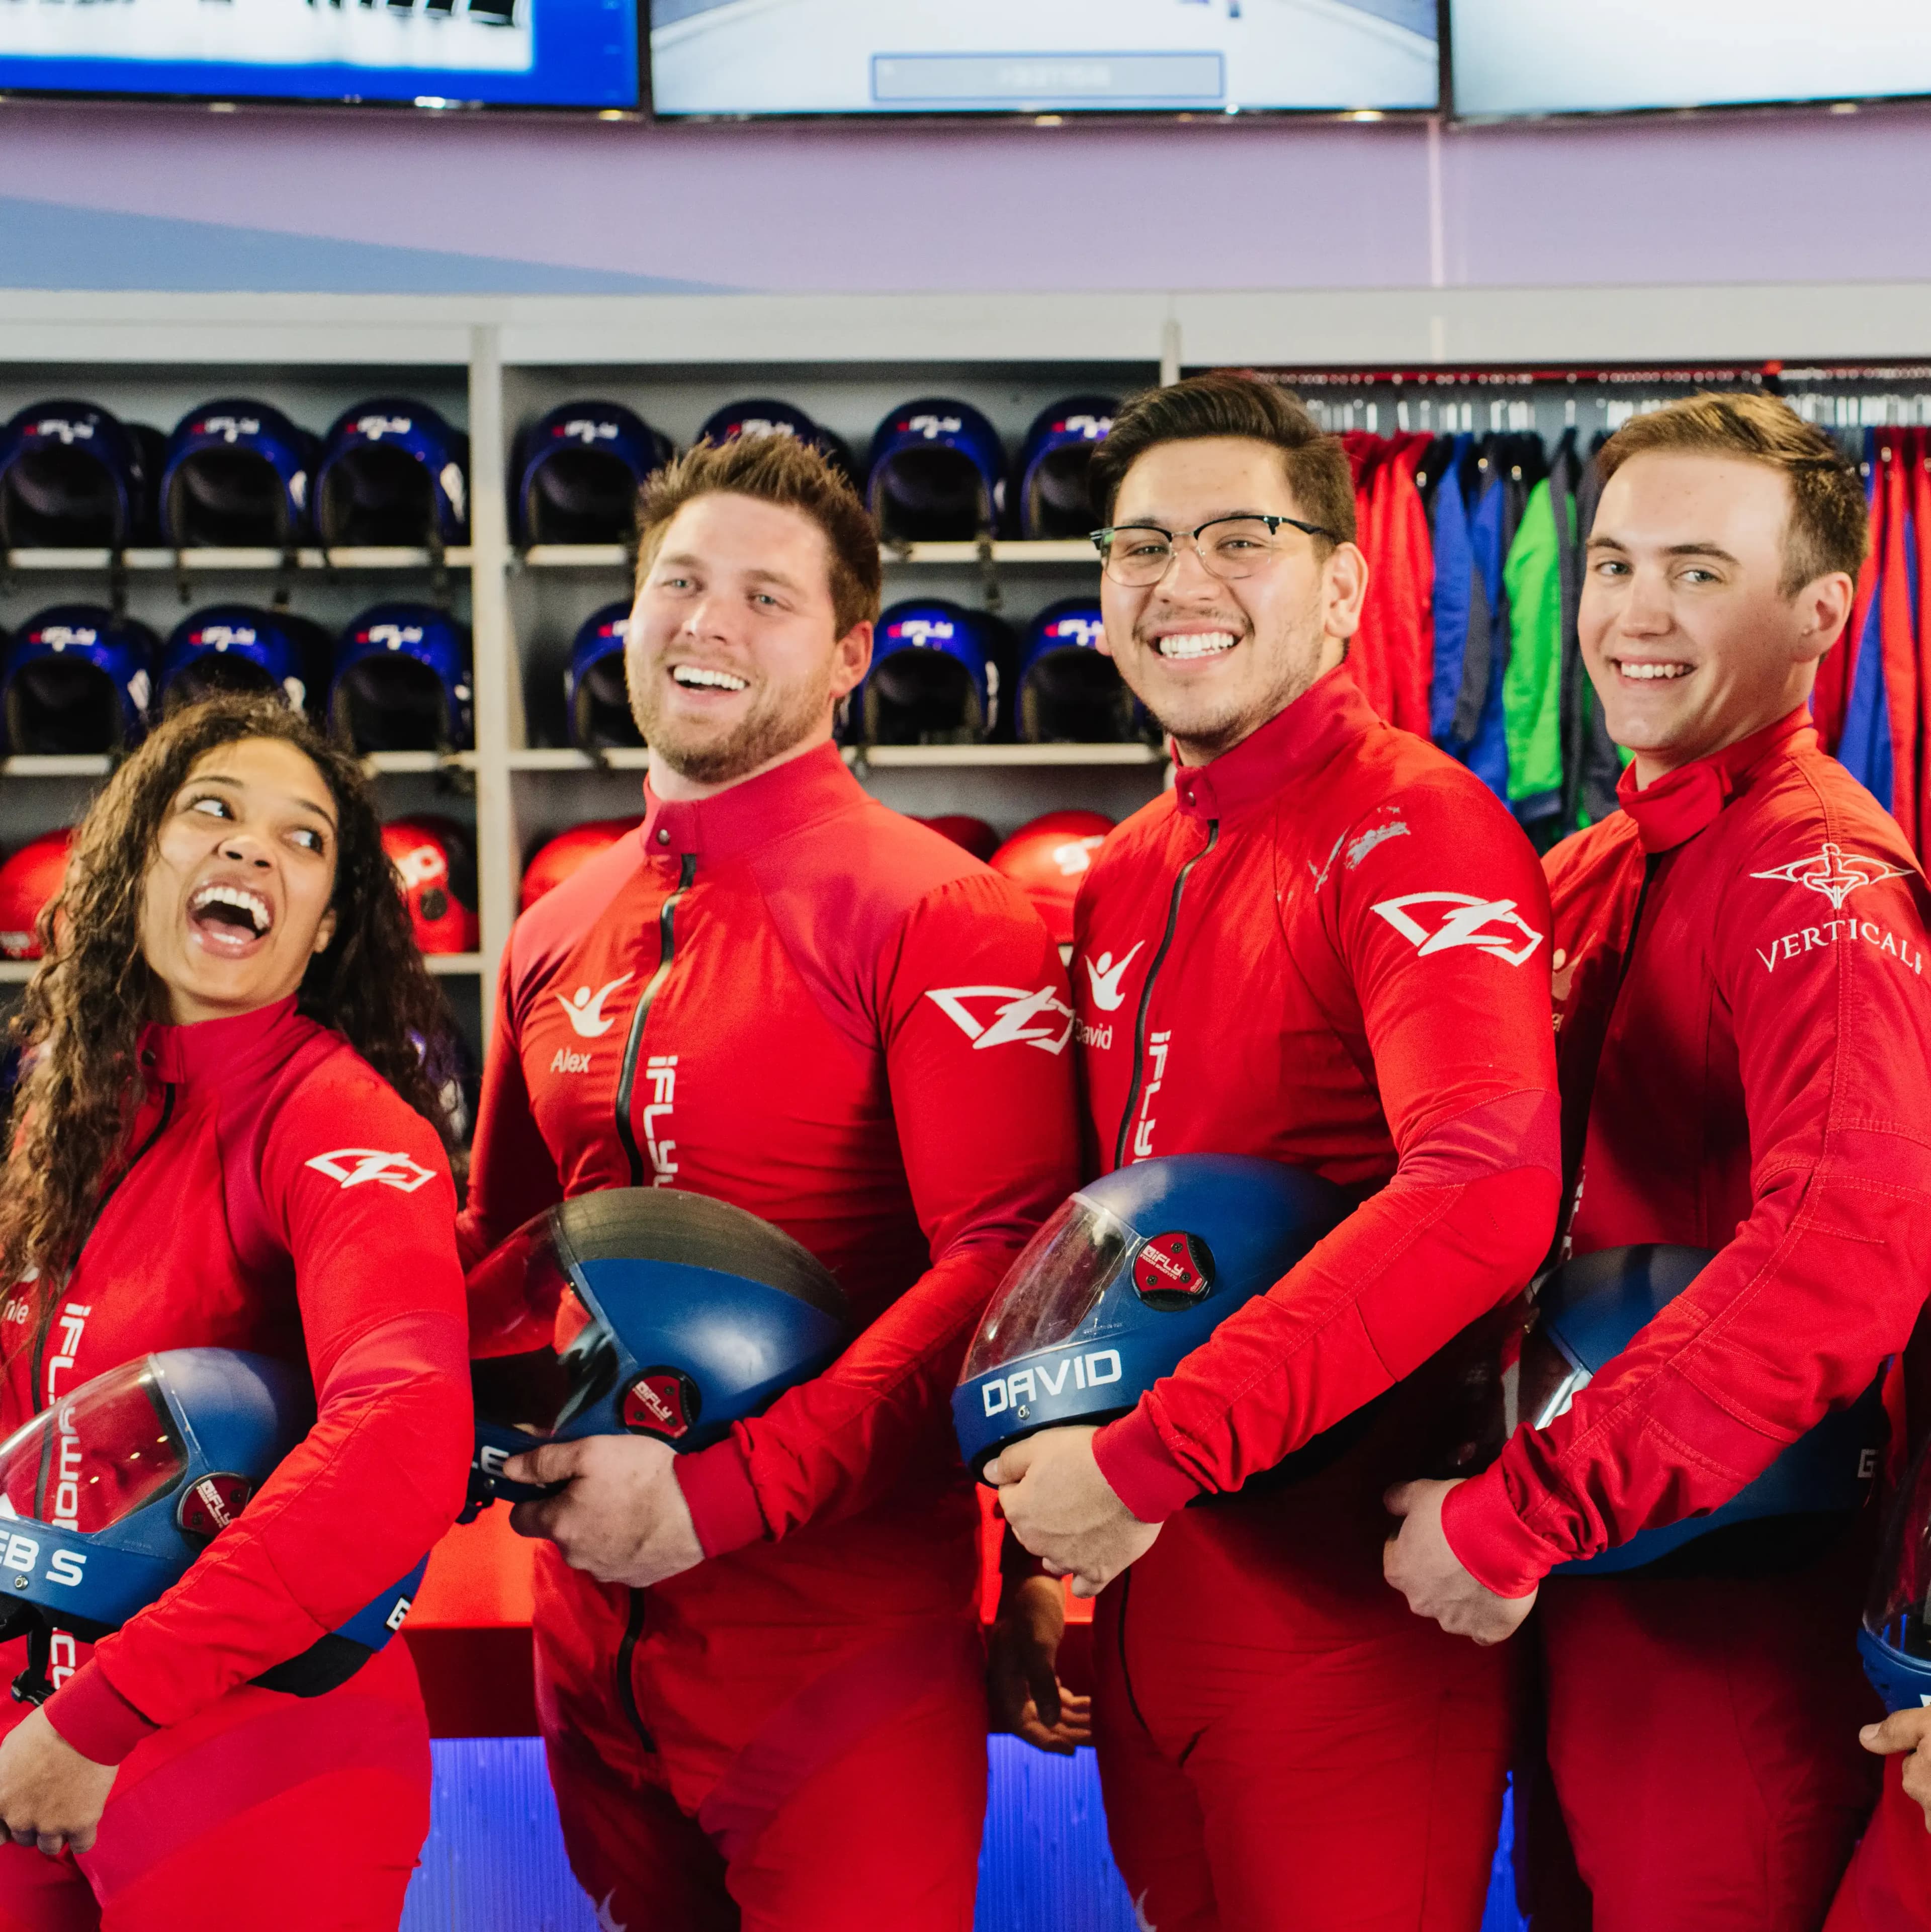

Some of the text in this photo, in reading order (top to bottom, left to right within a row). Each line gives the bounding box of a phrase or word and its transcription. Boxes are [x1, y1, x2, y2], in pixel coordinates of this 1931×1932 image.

[550, 1047, 591, 1073] Alex
[1132, 1030, 1172, 1164] iFLY
[2, 1297, 29, 1325] nie
[982, 1349, 1122, 1417] DAVID
[45, 1549, 87, 1587] S
